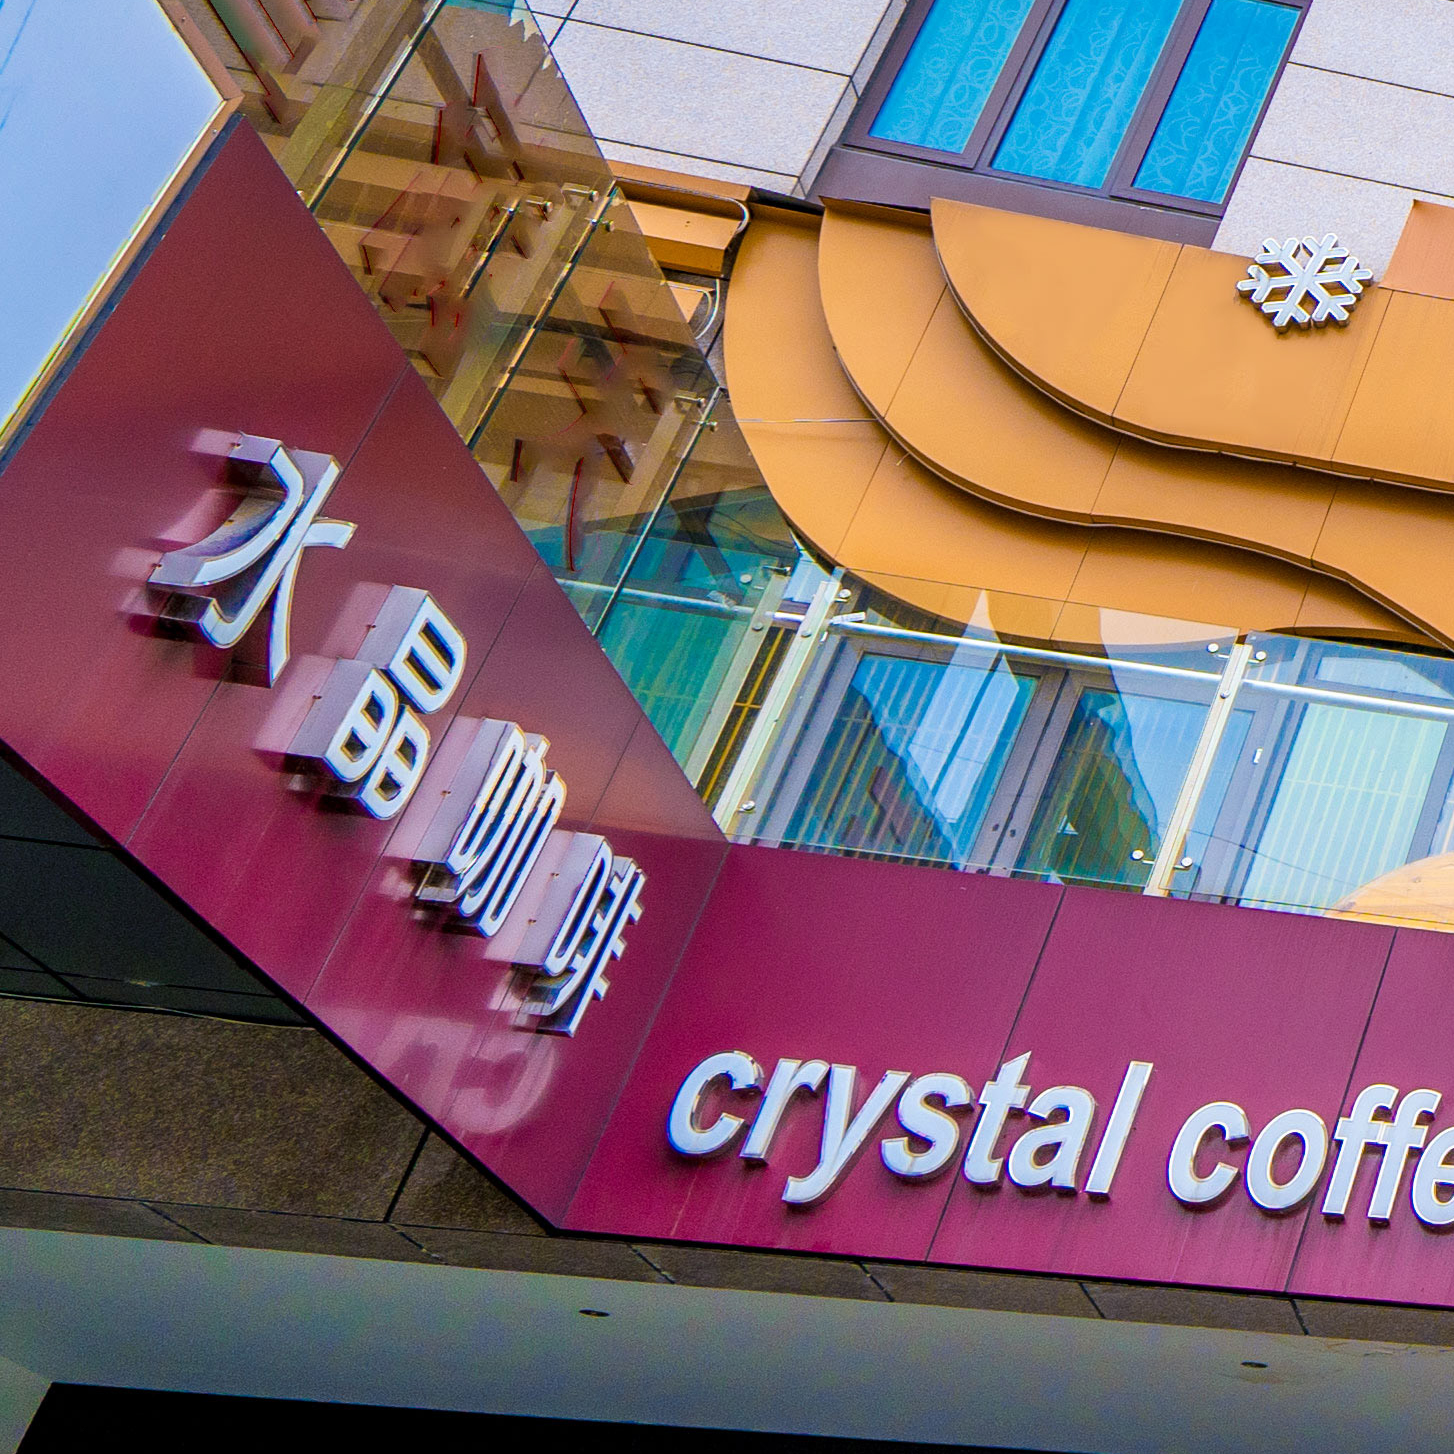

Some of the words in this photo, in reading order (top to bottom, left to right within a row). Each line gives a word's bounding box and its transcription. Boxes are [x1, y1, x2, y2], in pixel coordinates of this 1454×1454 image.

[148, 434, 646, 1036] 水晶咖啡
[666, 1048, 1152, 1206] crystal
